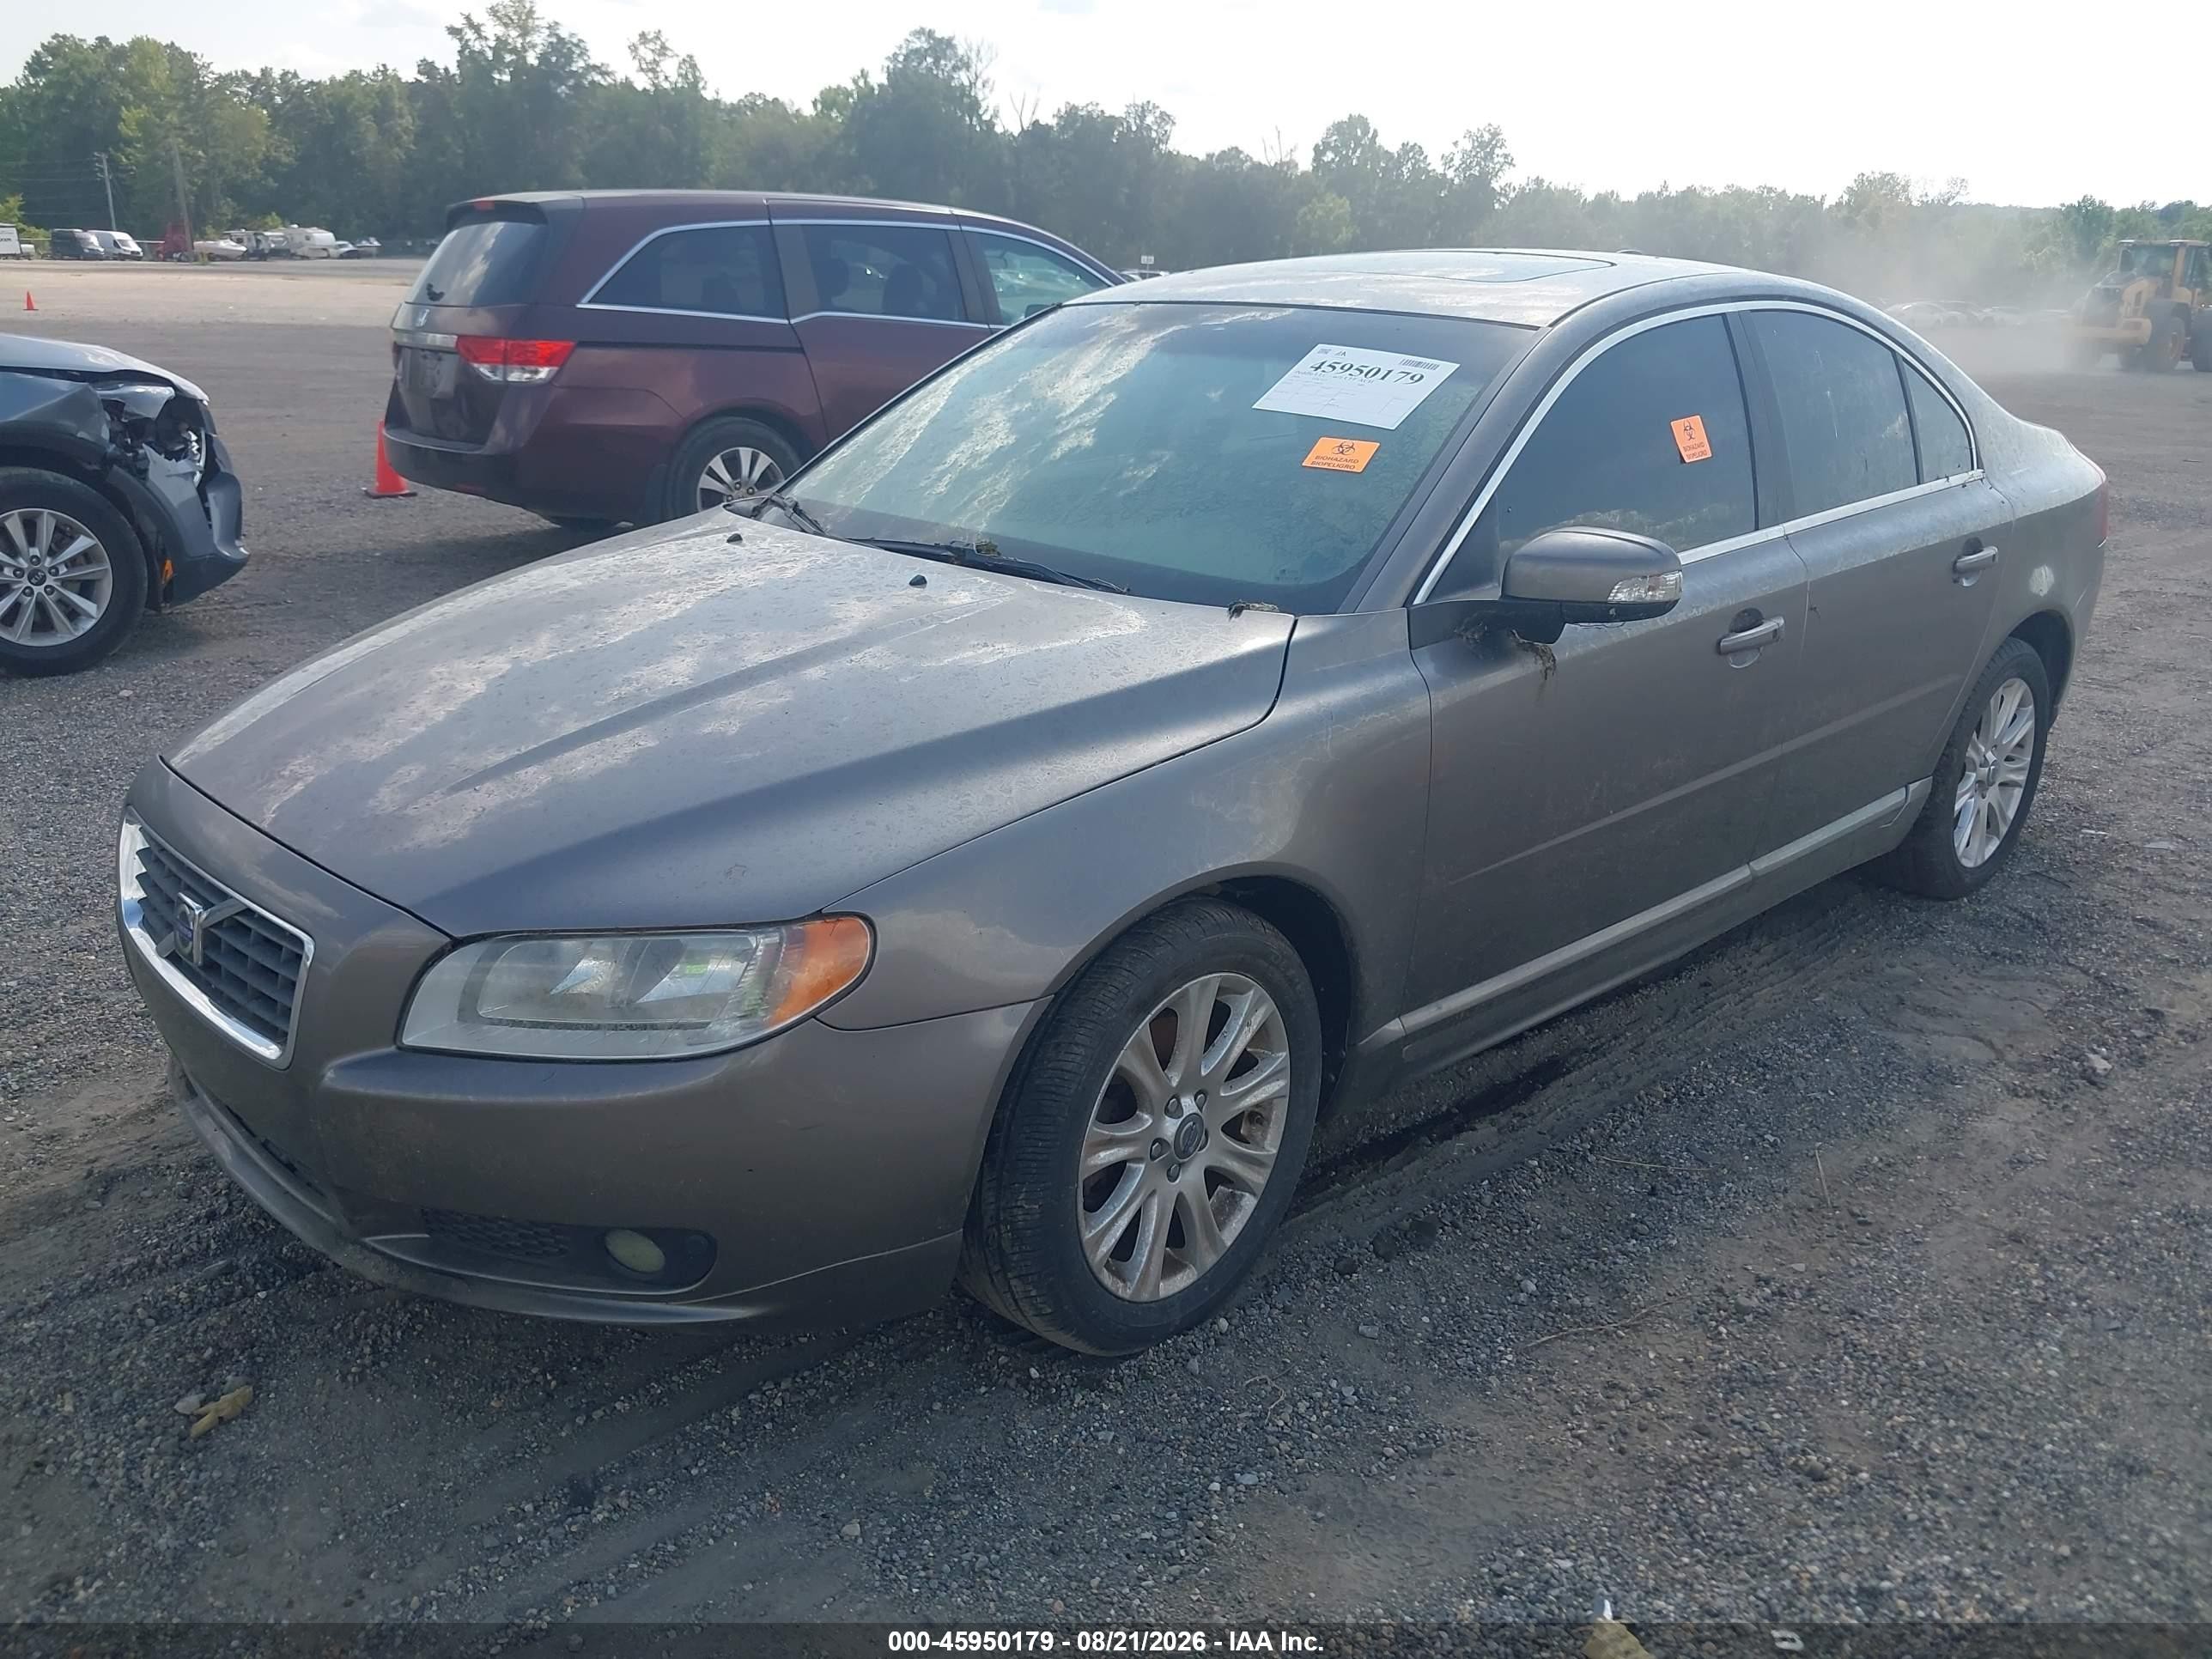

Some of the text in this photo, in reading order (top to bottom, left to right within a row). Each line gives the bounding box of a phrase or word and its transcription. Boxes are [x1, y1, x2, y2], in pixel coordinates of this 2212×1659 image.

[1310, 359, 1425, 385] 45950179
[1314, 455, 1359, 464] BIOHAZARD
[1310, 461, 1356, 470] BIOPELIGRO
